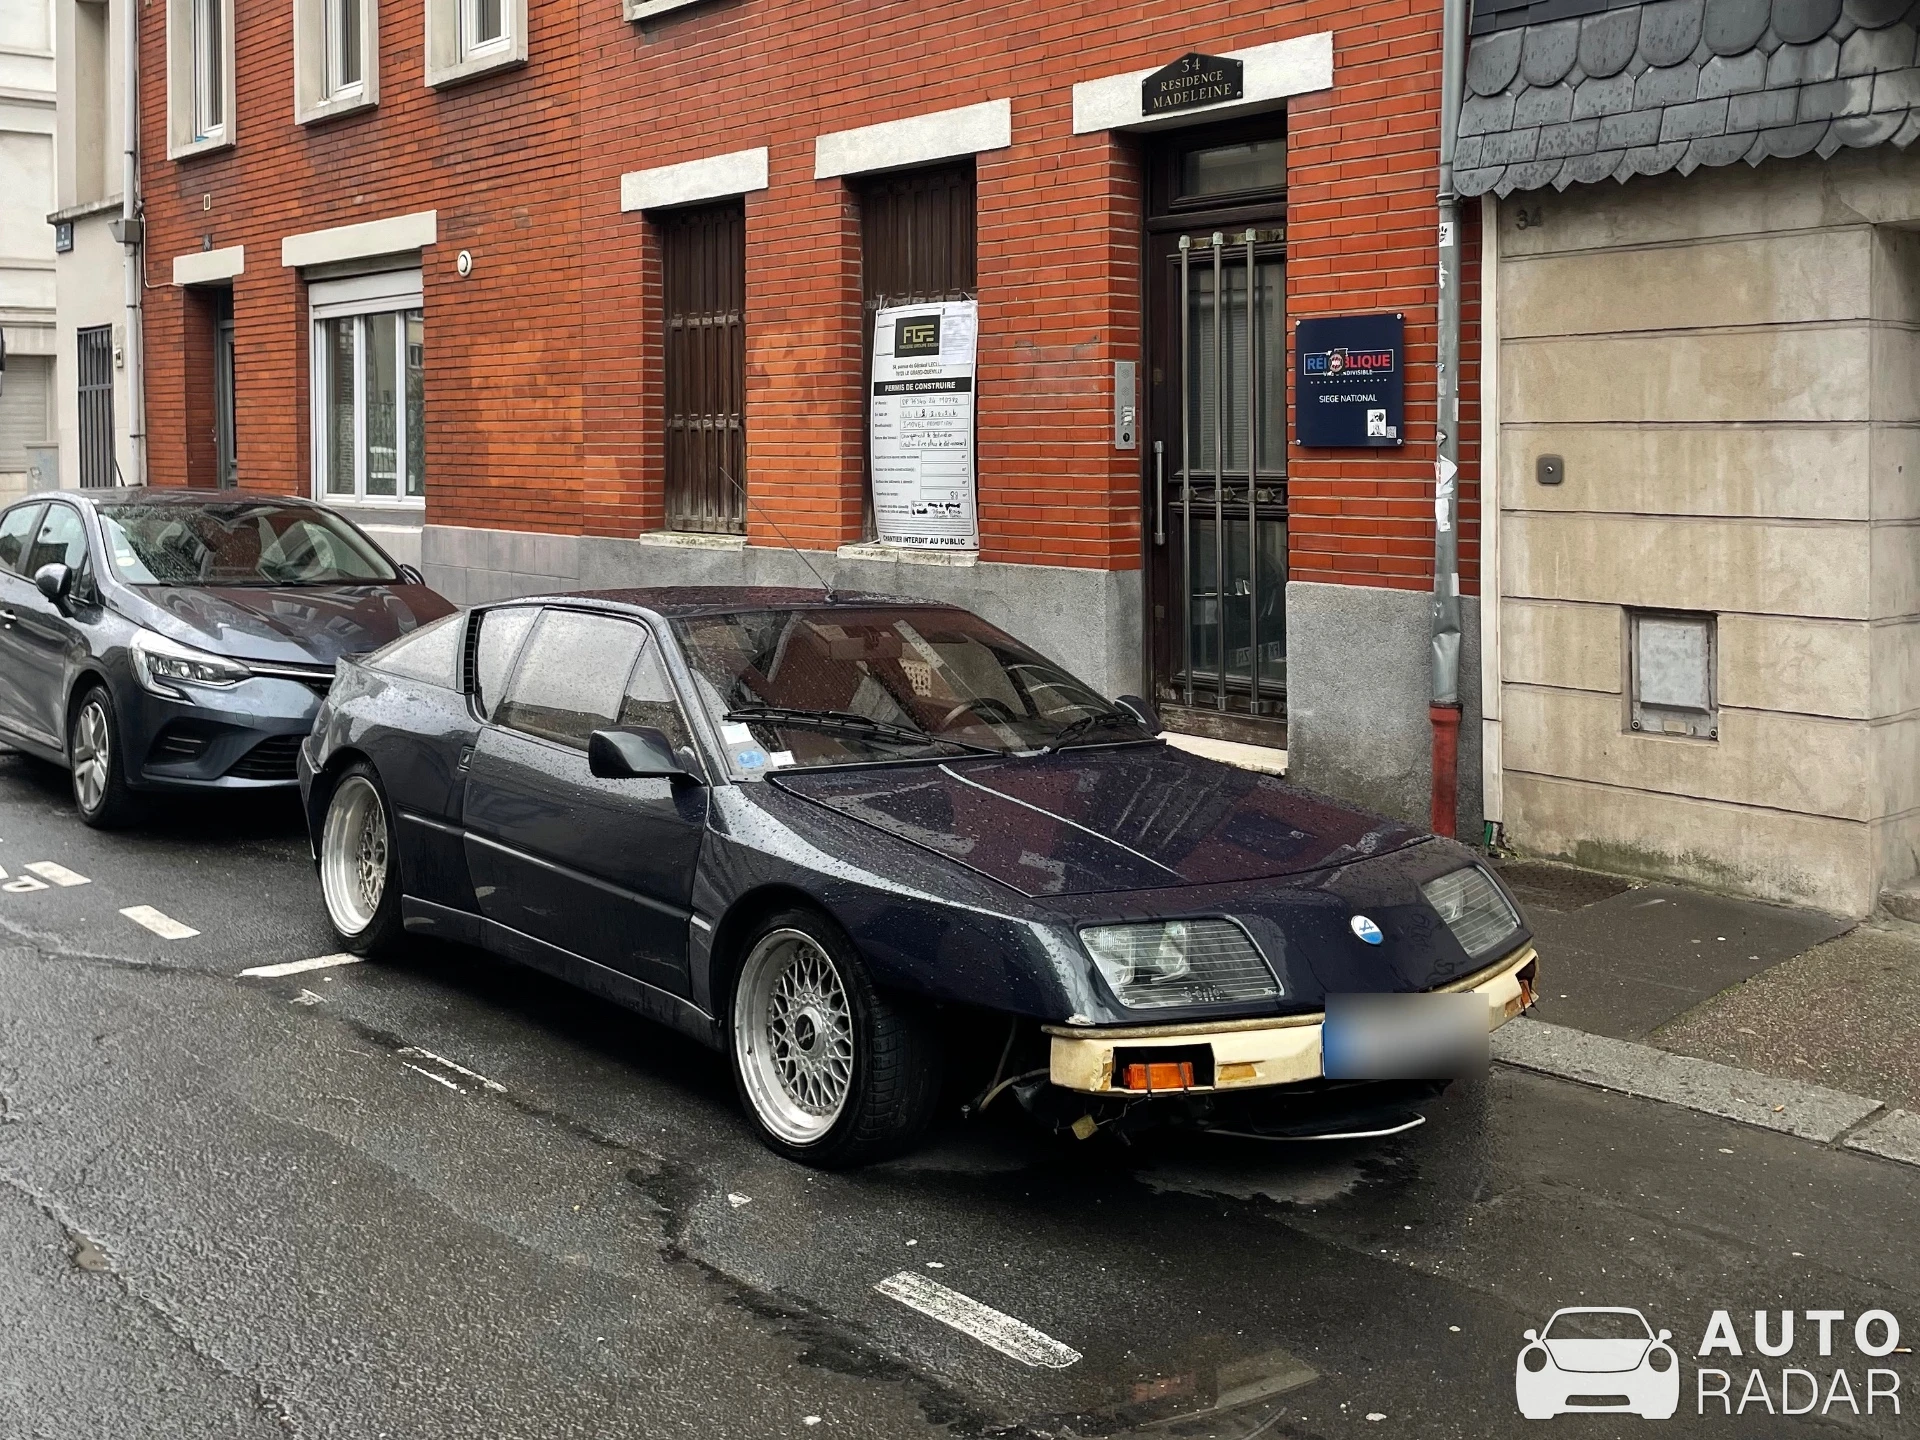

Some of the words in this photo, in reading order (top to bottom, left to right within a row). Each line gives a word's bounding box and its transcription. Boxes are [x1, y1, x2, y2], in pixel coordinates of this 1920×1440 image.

[1181, 57, 1200, 73] 34
[1160, 70, 1224, 92] RESIDENCE
[1153, 82, 1232, 109] MADELEINE
[884, 383, 905, 393] PERMIS
[906, 383, 914, 391] DE
[914, 381, 956, 390] CONSTRUIRE
[1319, 395, 1340, 403] SIEGE
[1340, 394, 1378, 402] NATIONAL
[882, 534, 904, 543] CHANTIER
[903, 536, 929, 545] INTERDIT
[929, 537, 939, 545] AU
[940, 538, 966, 546] PUBLIC
